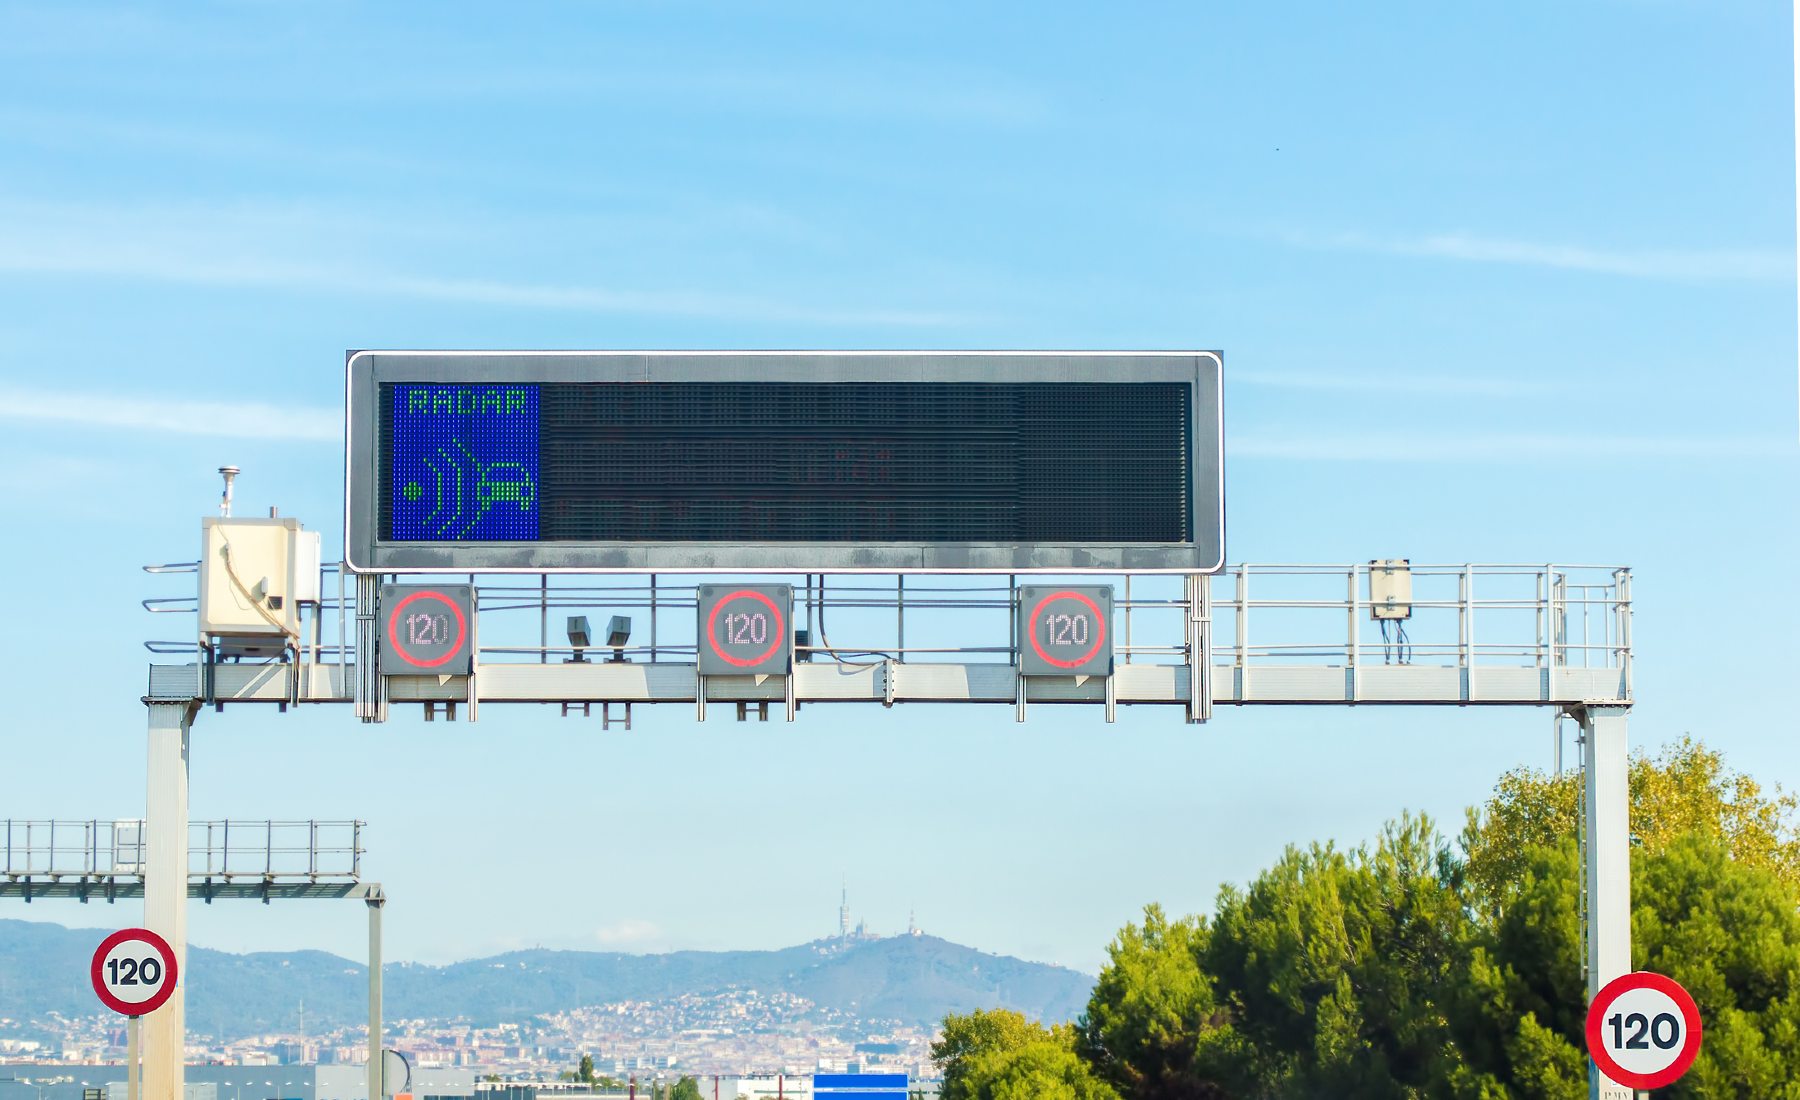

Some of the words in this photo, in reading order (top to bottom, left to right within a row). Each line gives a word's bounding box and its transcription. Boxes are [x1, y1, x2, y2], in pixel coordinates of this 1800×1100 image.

[409, 389, 525, 414] RADAR
[406, 614, 448, 645] 120
[725, 613, 767, 644] 120
[1046, 614, 1088, 645] 120
[107, 957, 161, 985] 120
[1608, 1012, 1680, 1050] 120
